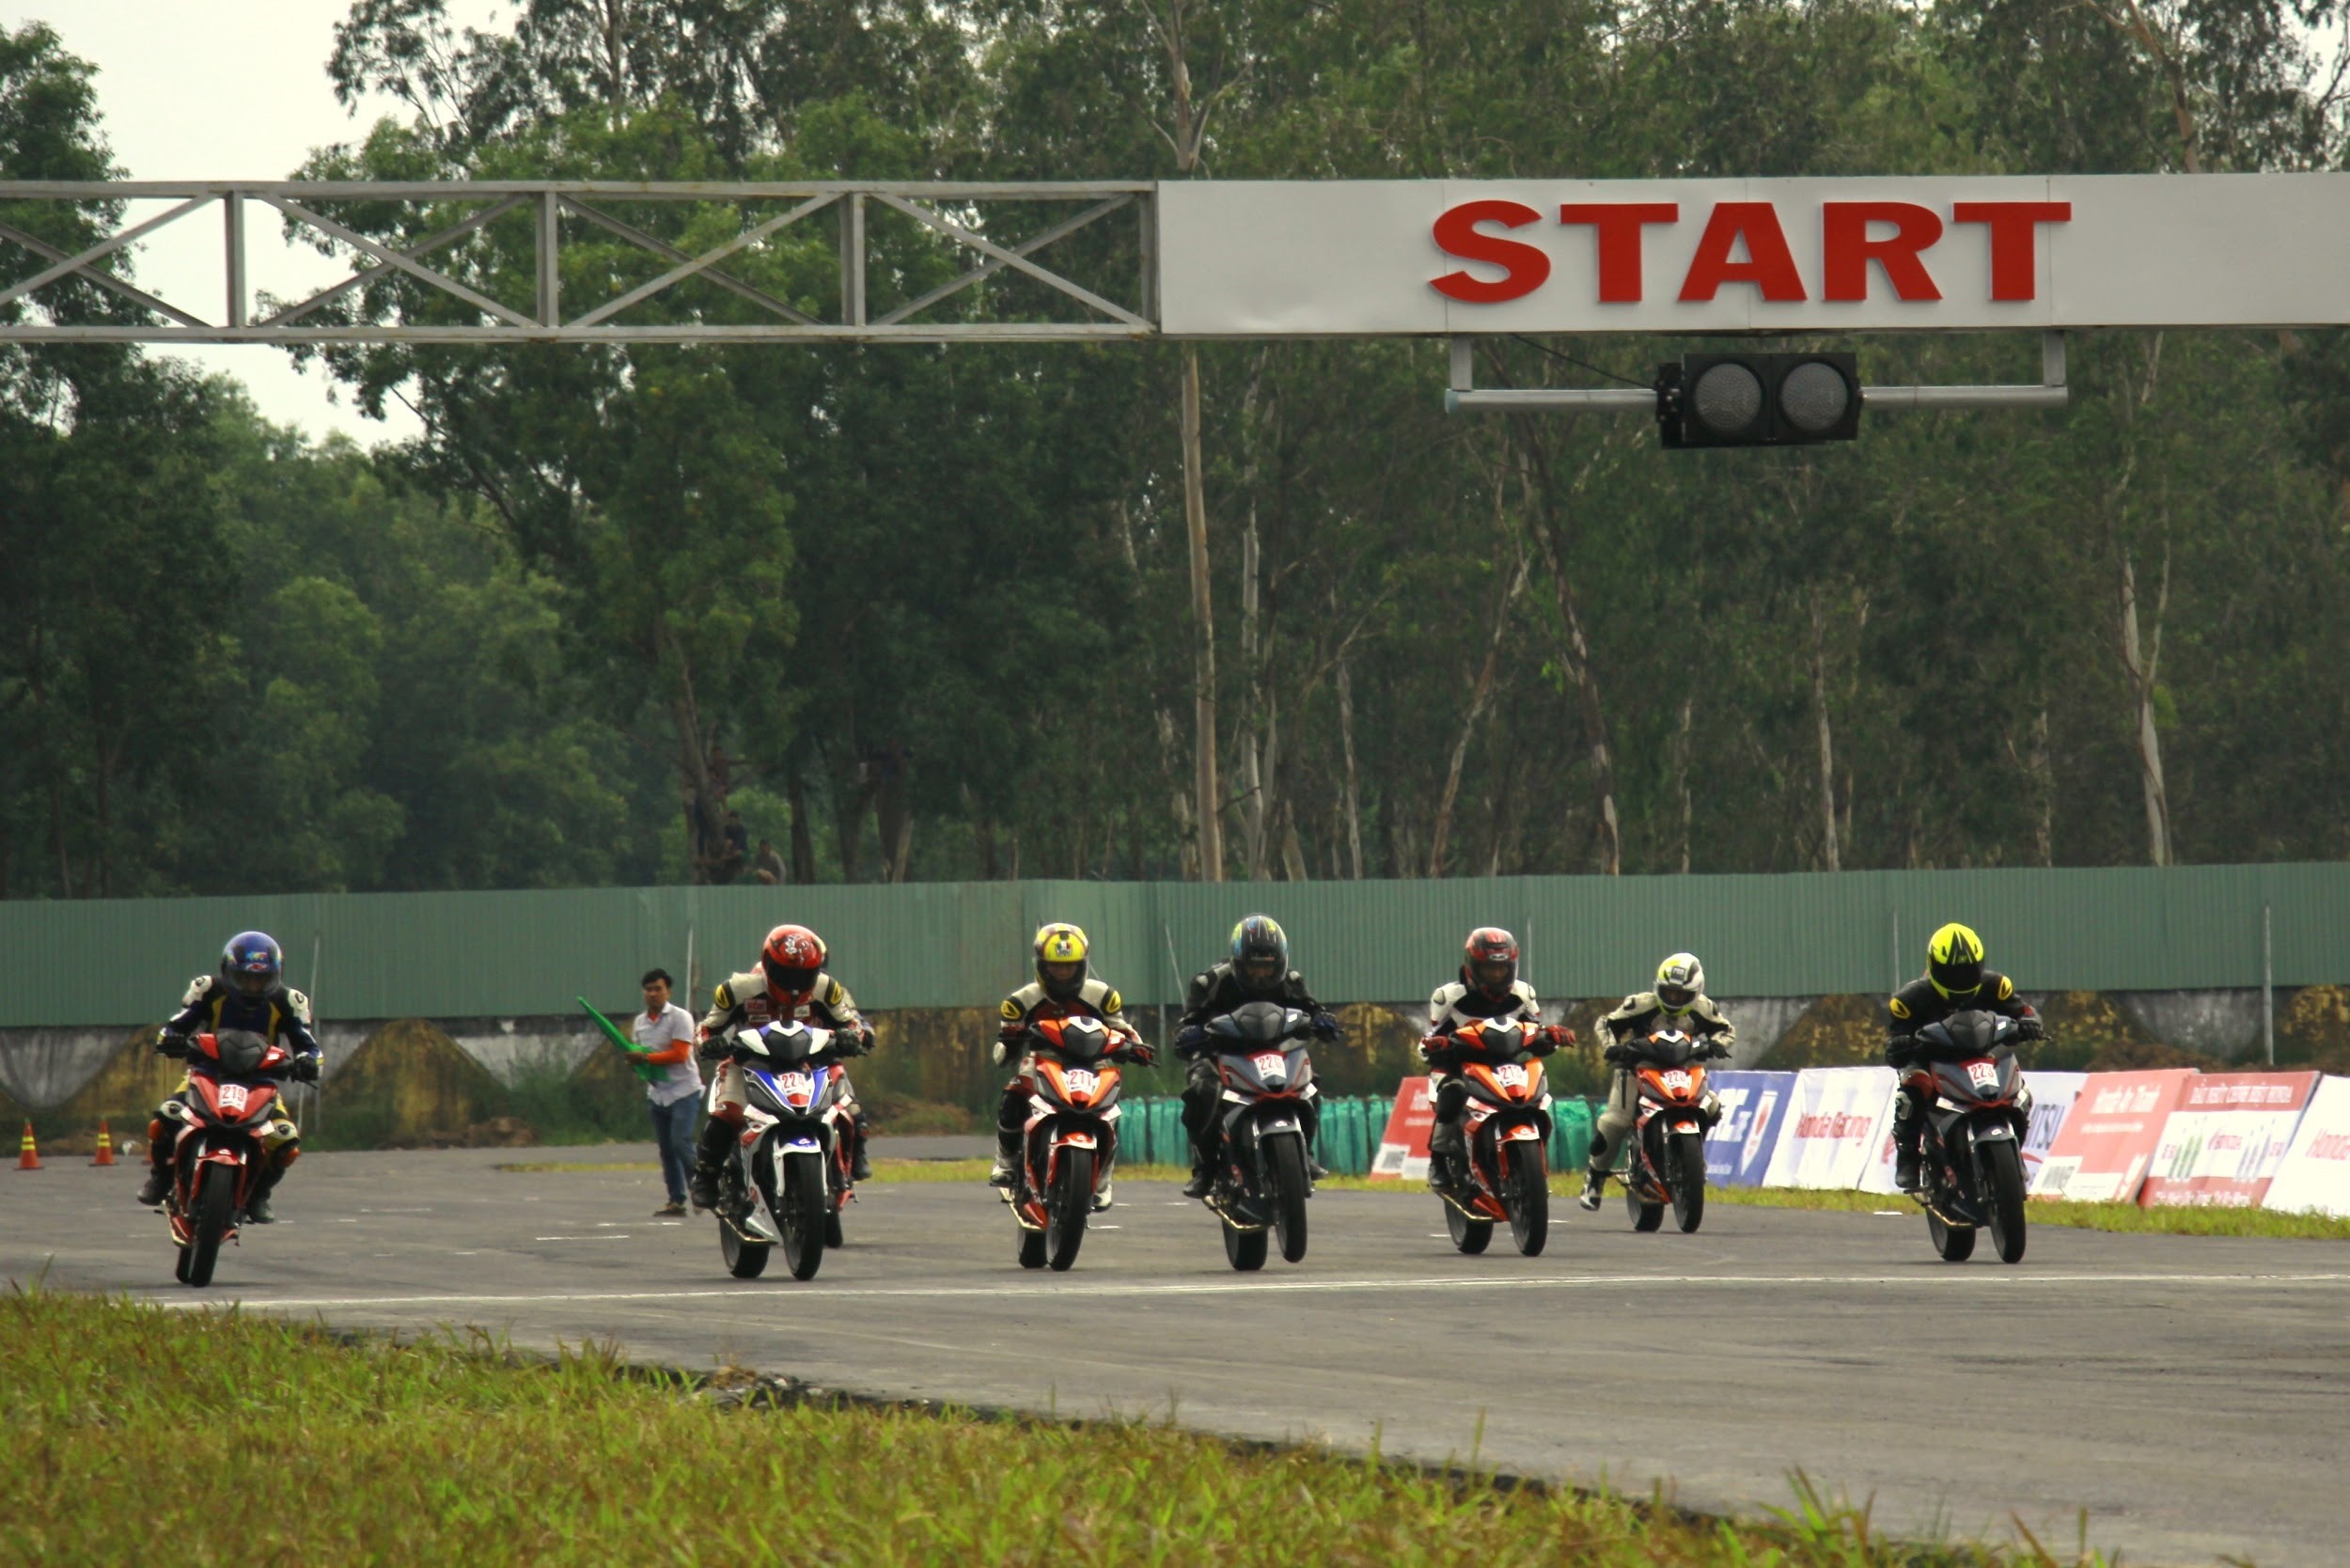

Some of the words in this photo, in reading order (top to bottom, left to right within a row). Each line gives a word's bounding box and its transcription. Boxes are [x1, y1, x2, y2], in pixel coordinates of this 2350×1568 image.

[1429, 199, 2072, 304] START
[1070, 1070, 1091, 1087] 211
[1970, 1064, 1995, 1080] 223
[222, 1085, 244, 1102] 219
